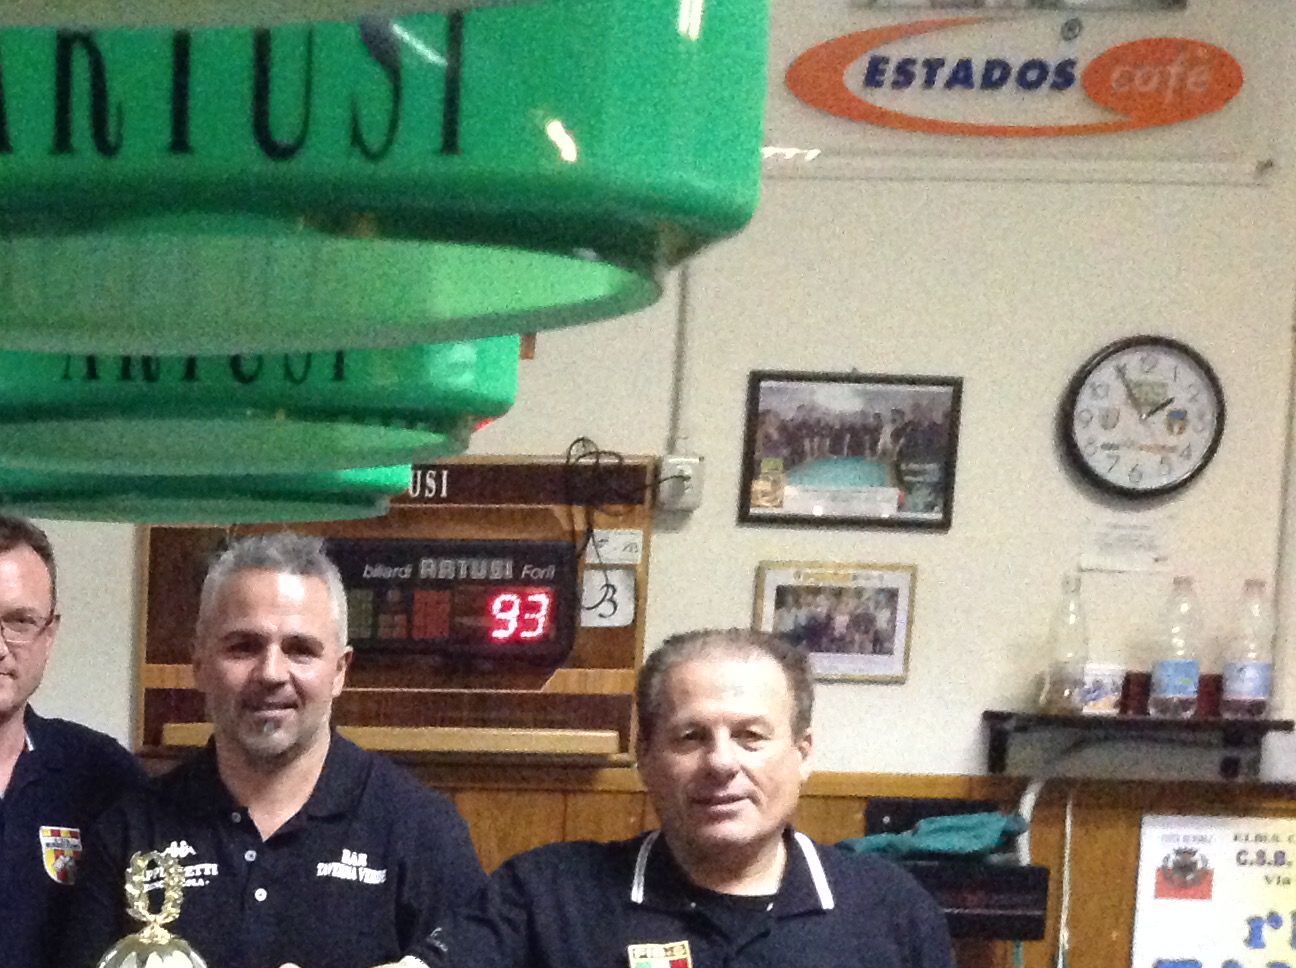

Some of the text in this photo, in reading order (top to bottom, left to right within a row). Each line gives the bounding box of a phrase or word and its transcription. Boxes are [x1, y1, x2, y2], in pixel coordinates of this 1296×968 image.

[863, 54, 1079, 91] ESTADOS
[408, 469, 448, 498] USI
[490, 592, 551, 640] 93
